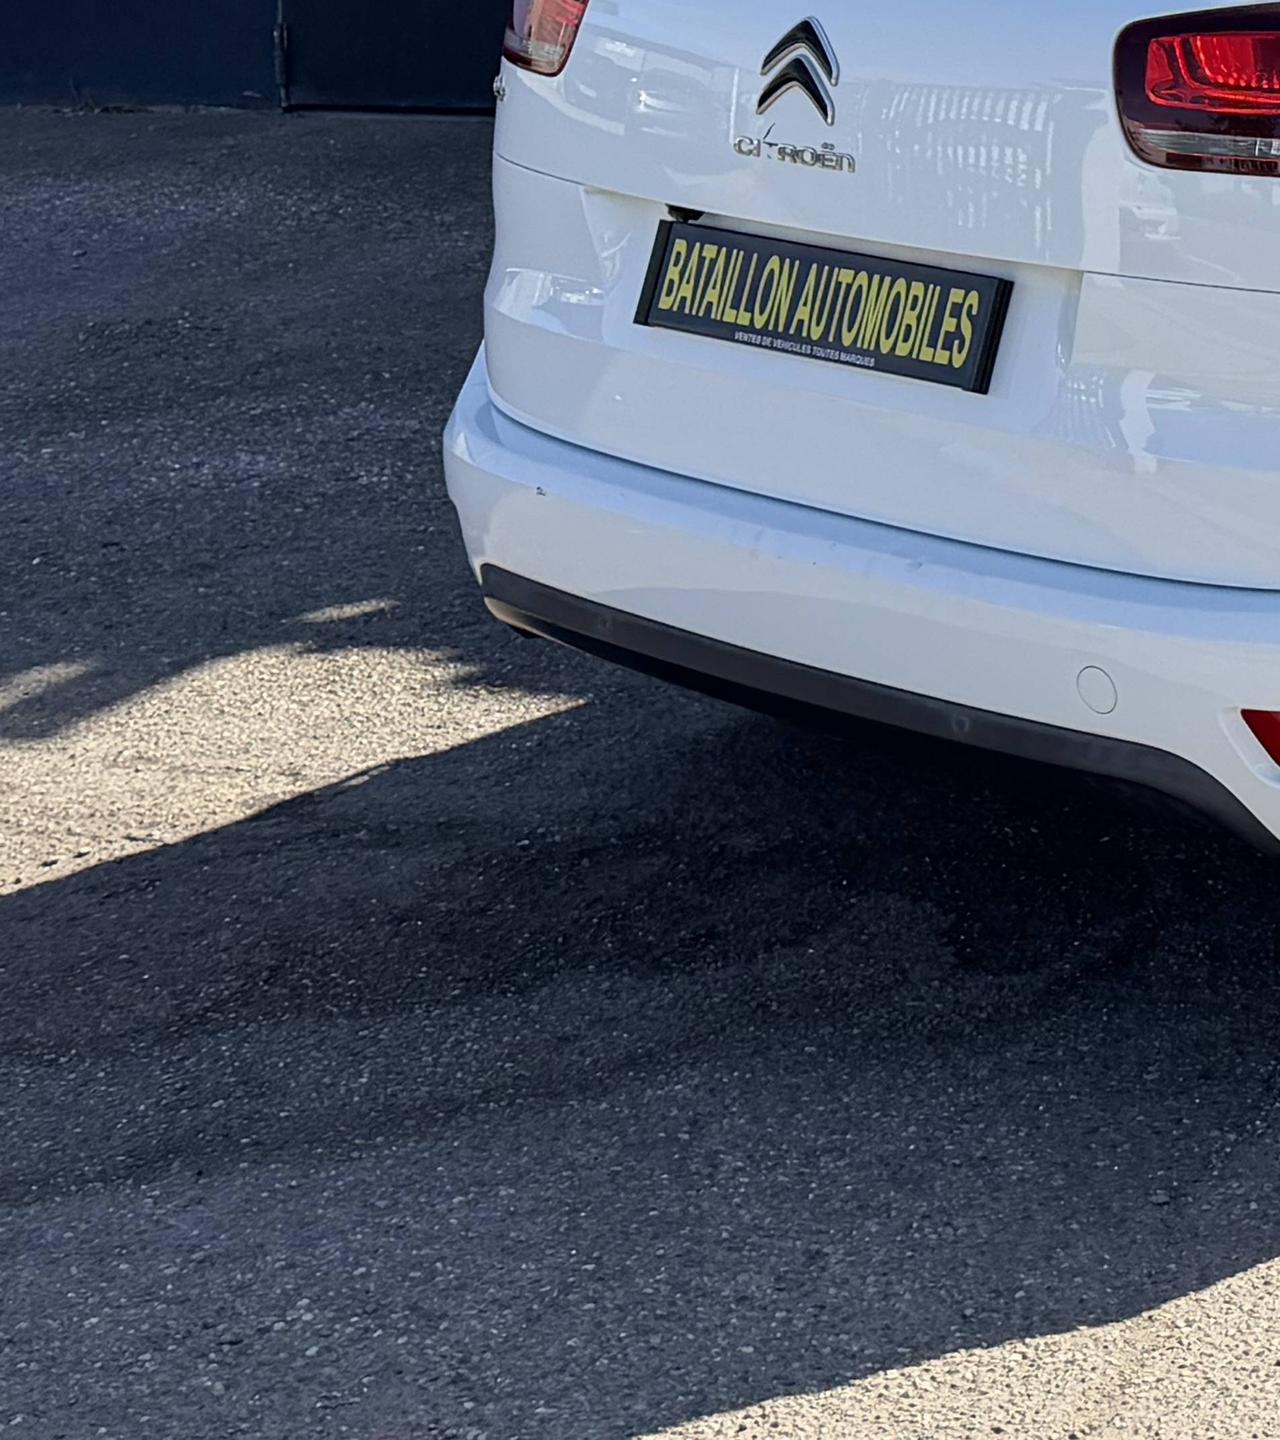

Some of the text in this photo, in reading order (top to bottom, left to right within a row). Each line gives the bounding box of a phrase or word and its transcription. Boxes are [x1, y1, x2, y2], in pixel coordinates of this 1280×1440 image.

[658, 238, 979, 369] BATAILLON AUTOMOBILES
[734, 331, 761, 345] VENTES
[761, 336, 772, 347] DE
[812, 346, 840, 361] TOUTES
